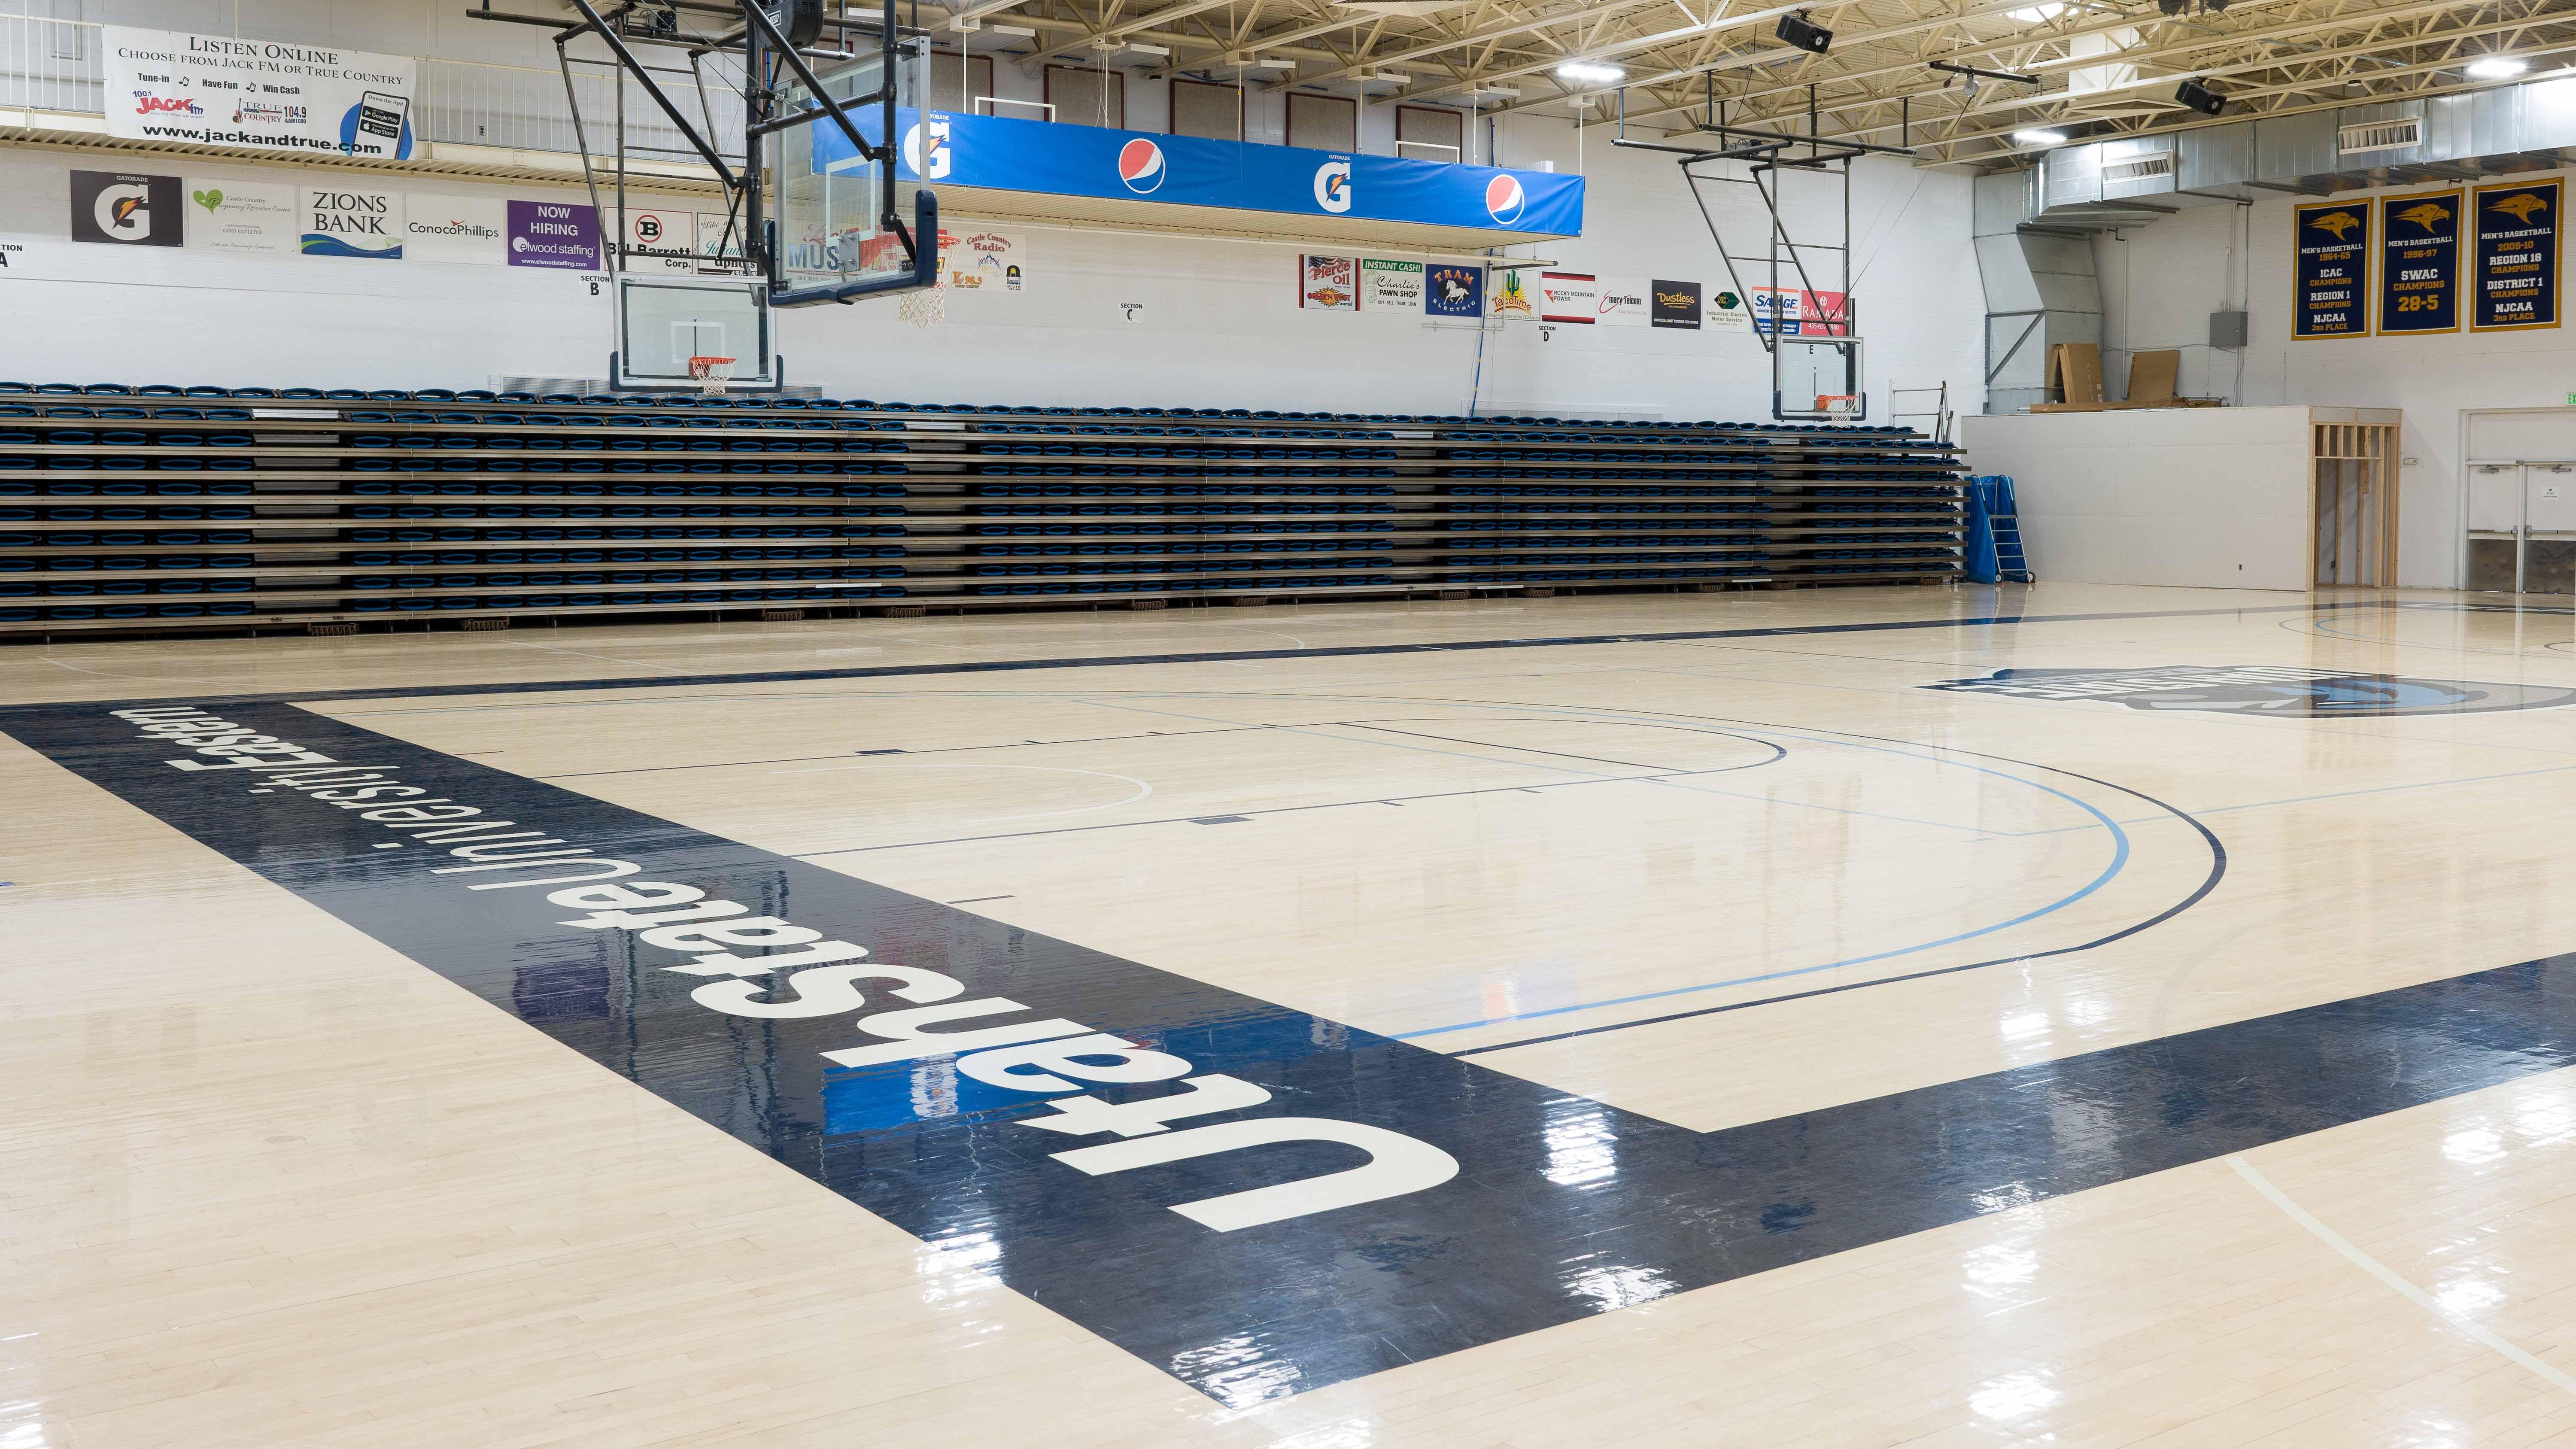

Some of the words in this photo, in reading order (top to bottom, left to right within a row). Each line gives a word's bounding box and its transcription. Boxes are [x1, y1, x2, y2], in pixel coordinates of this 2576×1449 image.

[258, 61, 280, 72] FM
[138, 73, 169, 83] Tune-in
[202, 79, 222, 88] Have
[224, 81, 238, 89] Fun
[263, 84, 278, 93] Win
[136, 97, 194, 114] JACK
[190, 103, 204, 115] fm
[243, 101, 282, 111] TRUE
[284, 106, 306, 118] 104.9
[372, 112, 388, 120] Google
[244, 113, 282, 124] COUNTRY
[143, 126, 381, 154] www.jackandtrue.com
[1314, 162, 1351, 213] G
[209, 198, 244, 212] Pregnancy
[313, 191, 387, 213] ZIONS
[94, 184, 150, 240] G
[538, 206, 570, 219] NOW
[313, 213, 388, 235] BANK
[531, 222, 578, 236] HIRING
[640, 221, 659, 236] B
[409, 222, 498, 239] ConocoPhillips
[2504, 228, 2552, 238] BASKETBALL
[967, 234, 985, 244] Castle
[987, 233, 1011, 248] Country
[2410, 236, 2453, 246] BASKETBALL
[2497, 240, 2534, 251] 2009-10
[520, 241, 557, 253] elwood
[559, 244, 593, 258] staffing
[974, 243, 1005, 252] Radio
[2322, 243, 2363, 252] BASKETBALL
[2319, 252, 2351, 261] 1964-65
[2403, 249, 2437, 258] 1996-97
[2489, 254, 2527, 265] REGION
[2530, 253, 2542, 262] 18
[522, 259, 587, 267] www.elwoodstaffing.com
[665, 259, 691, 269] Corp.
[1365, 261, 1397, 270] INSTANT
[1399, 263, 1421, 272] CASH!
[2491, 263, 2540, 273] CHAMPIONS
[1313, 262, 1350, 280] Pierce
[2320, 268, 2342, 277] ICAC
[2401, 268, 2438, 281] SWAC
[965, 275, 982, 285] 98.3
[1333, 273, 1350, 285] Oil
[1434, 269, 1473, 285] TRAM
[2310, 278, 2352, 286] CHAMPIONS
[590, 282, 599, 295] B
[1377, 276, 1420, 290] Charlie's
[2393, 280, 2445, 291] CHAMPIONS
[2487, 278, 2536, 290] DISTRICT
[2538, 277, 2543, 286] 1
[1656, 292, 1695, 304] Dustless
[2311, 291, 2344, 301] REGION
[2491, 289, 2539, 298] CHAMPIONS
[1433, 298, 1476, 311] ELECTRIC
[1624, 296, 1641, 305] Telcom
[1755, 295, 1798, 309] SAGE
[2309, 301, 2351, 309] CHAMPIONS
[2398, 295, 2439, 312] 28-5
[2496, 302, 2533, 313] NJCAA
[1127, 309, 1133, 321] C
[2314, 313, 2346, 323] NJCAA
[2509, 313, 2535, 321] PLACE
[1543, 331, 1549, 342] D
[1810, 345, 1814, 354] E
[109, 706, 339, 771] Eastern
[248, 766, 641, 890] University
